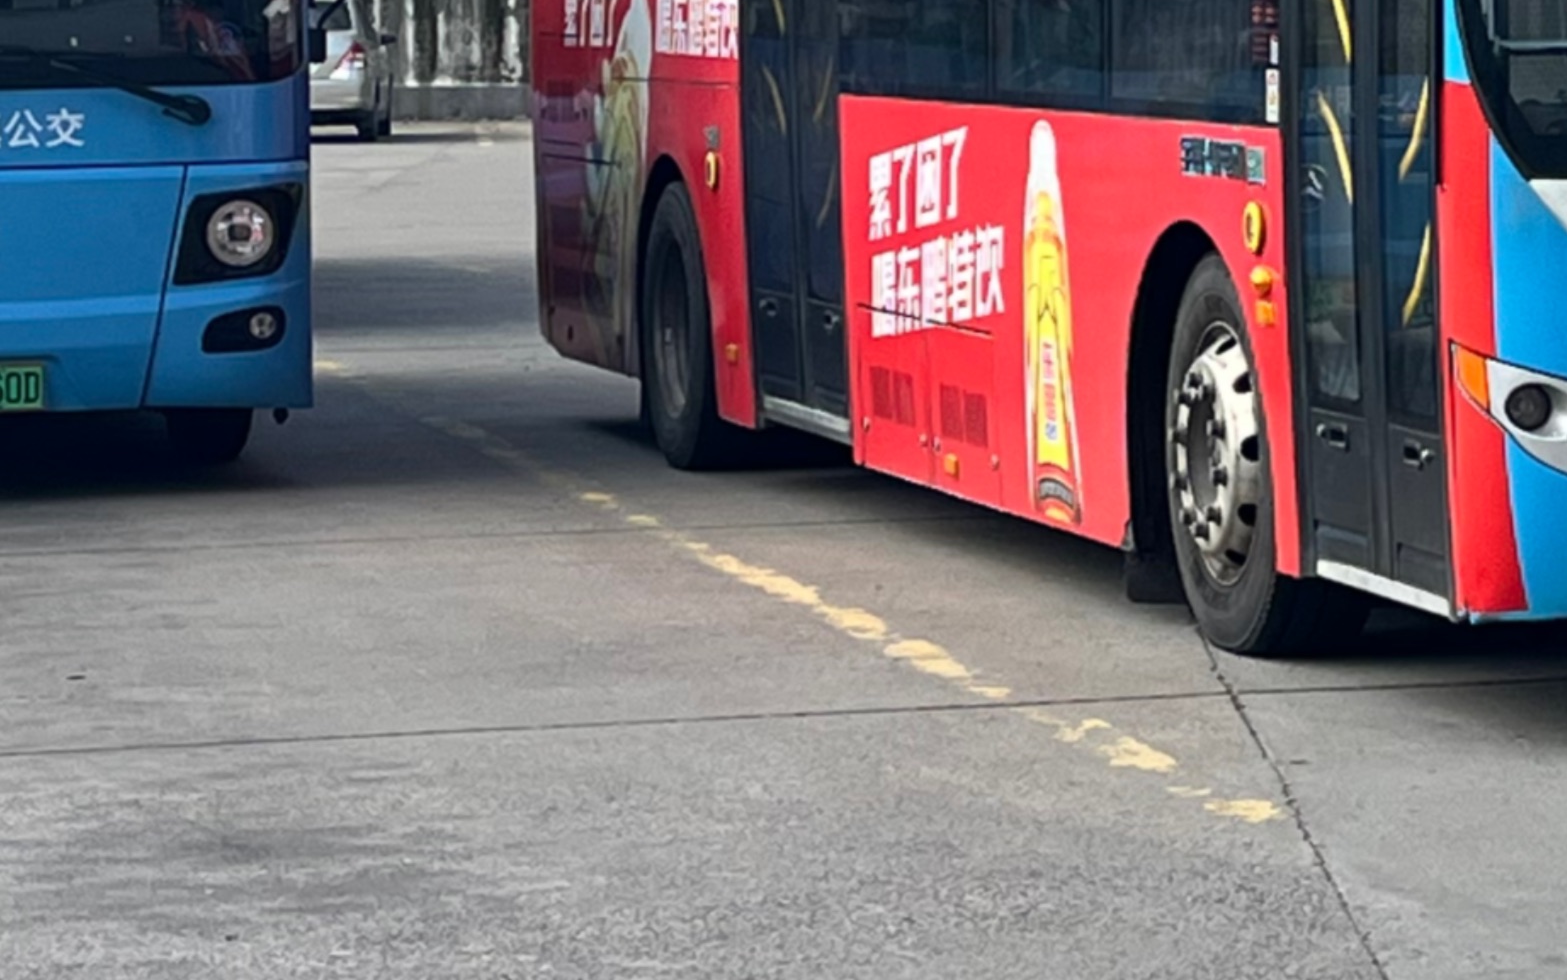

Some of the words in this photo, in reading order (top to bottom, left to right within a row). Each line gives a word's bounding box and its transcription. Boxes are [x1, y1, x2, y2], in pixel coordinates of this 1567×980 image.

[868, 125, 969, 241] 累了困了
[871, 222, 1005, 339] 喝东鹏特饮
[0, 371, 39, 404] 0D
